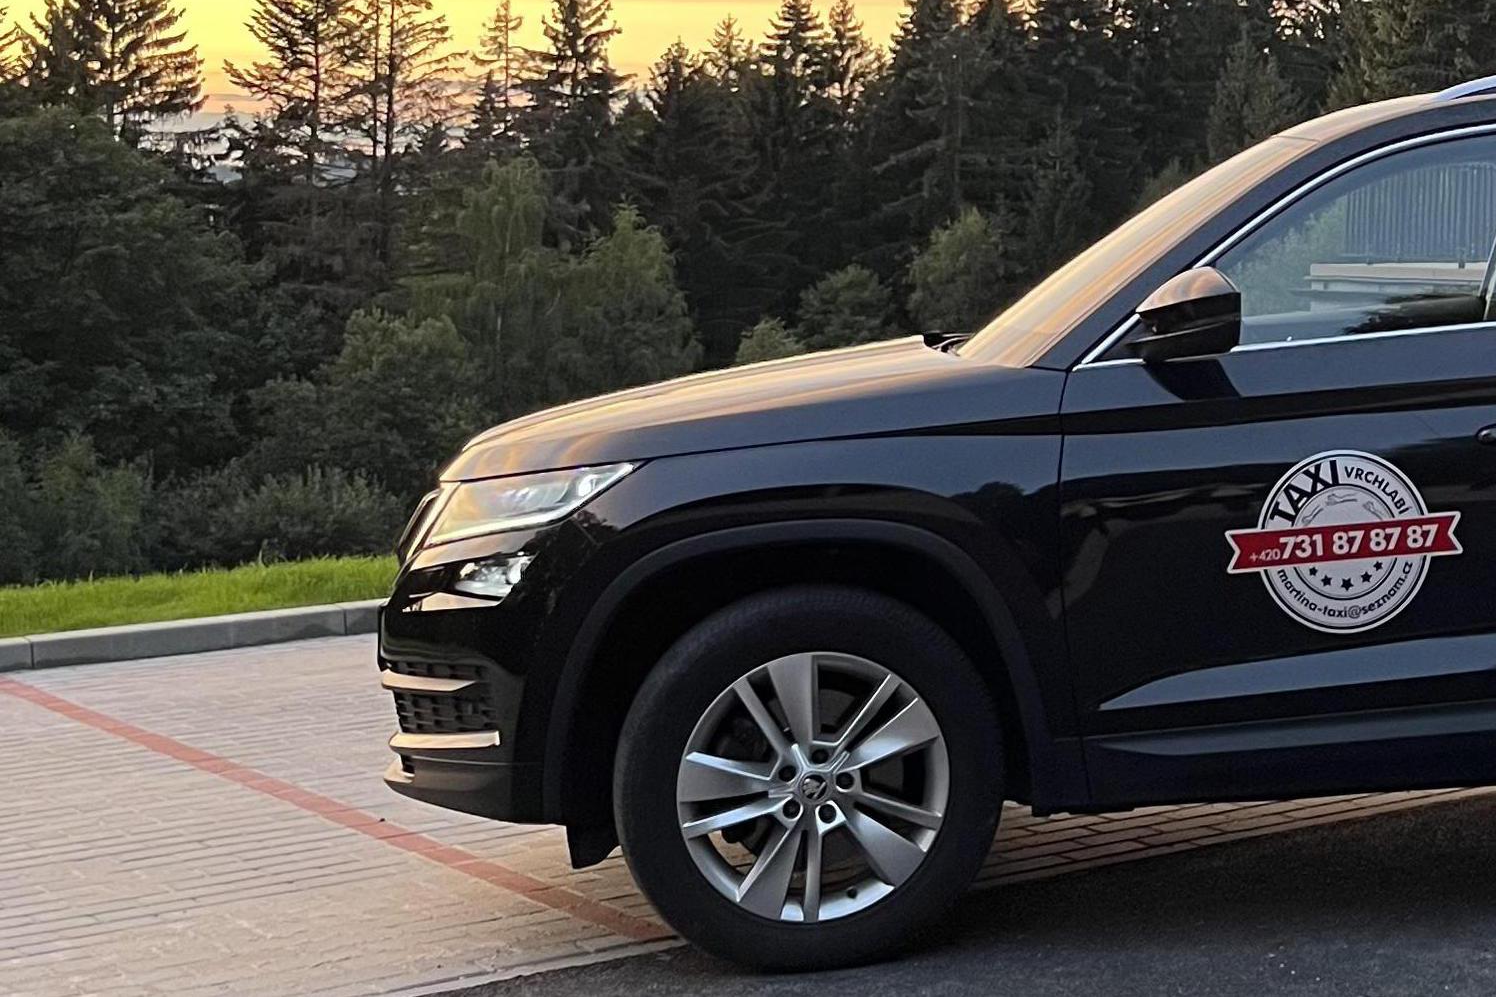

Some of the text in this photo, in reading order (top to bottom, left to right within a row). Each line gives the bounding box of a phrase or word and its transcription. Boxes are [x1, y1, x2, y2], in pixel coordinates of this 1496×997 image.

[1269, 459, 1413, 523] TAXI VRCHLABÍ
[1279, 533, 1324, 560] 731
[1332, 530, 1364, 554] 87
[1369, 527, 1402, 552] 87
[1406, 523, 1439, 548] 87
[1277, 561, 1413, 619] martina-taxi@seznam.cz
